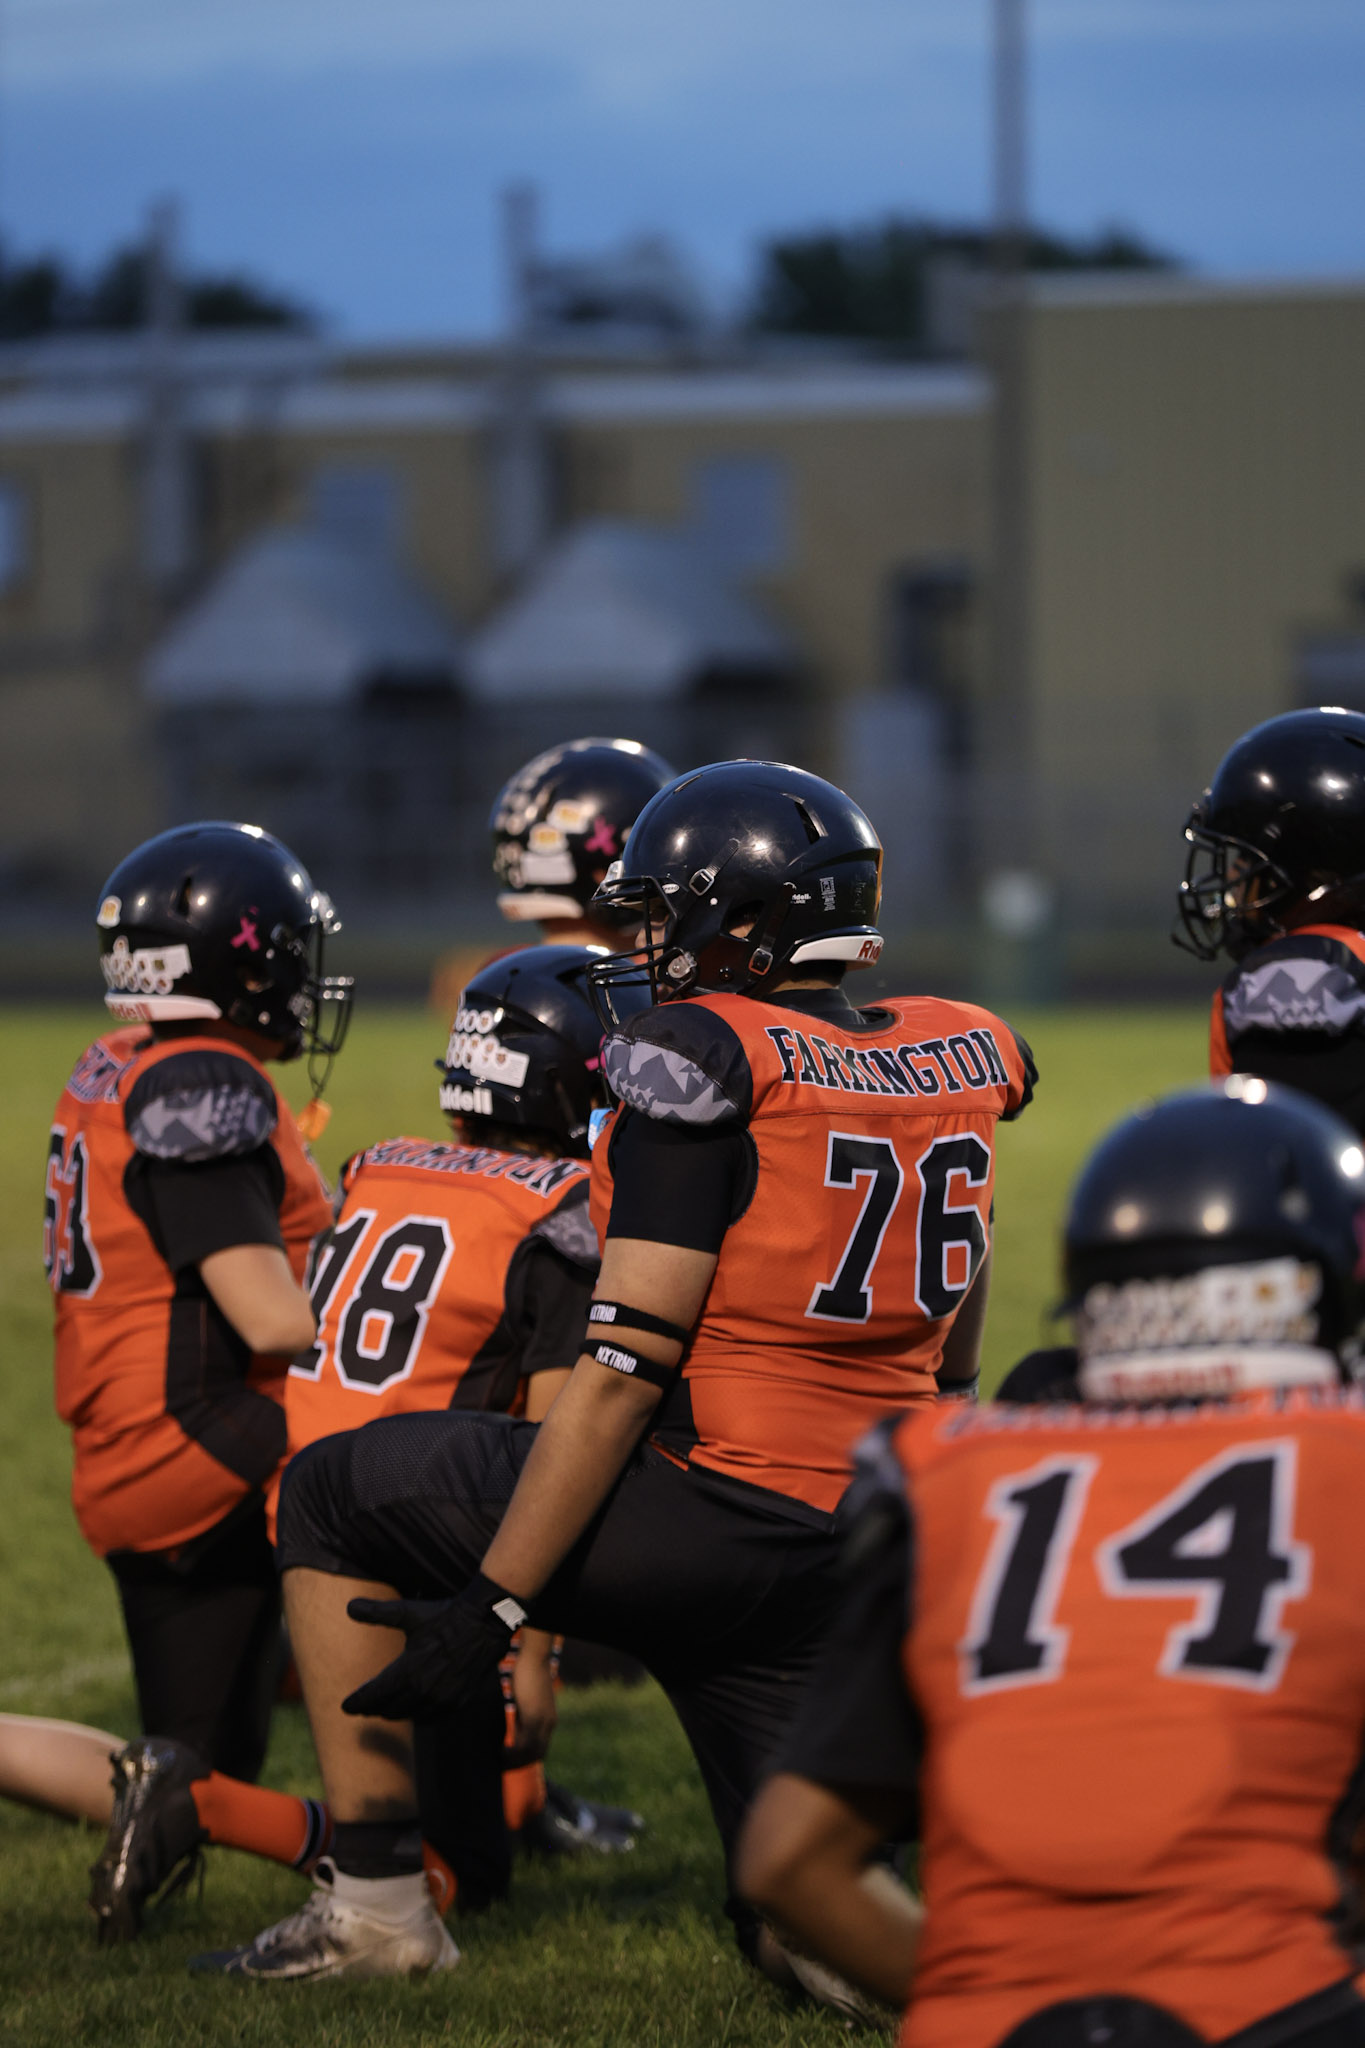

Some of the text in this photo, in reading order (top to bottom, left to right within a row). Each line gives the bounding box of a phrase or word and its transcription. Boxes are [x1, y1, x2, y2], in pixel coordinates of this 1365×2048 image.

[764, 1026, 1010, 1097] FARMINGTON
[288, 1208, 455, 1396] 18
[804, 1131, 992, 1325] 76
[595, 1345, 637, 1374] NXTRND
[956, 1435, 1314, 1697] 14
